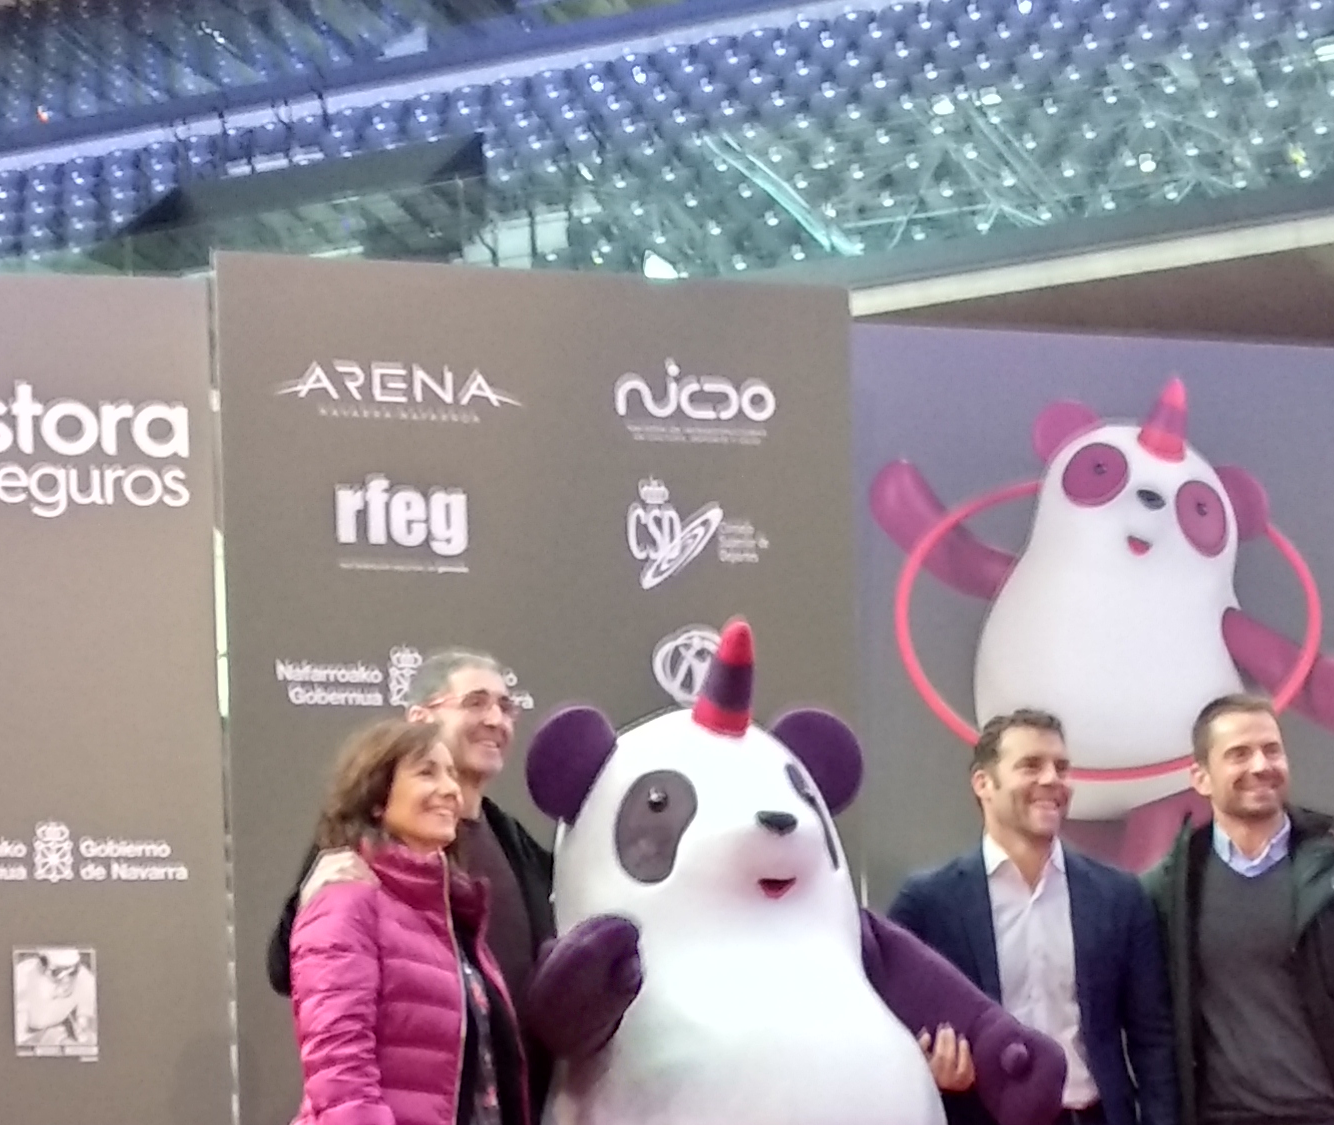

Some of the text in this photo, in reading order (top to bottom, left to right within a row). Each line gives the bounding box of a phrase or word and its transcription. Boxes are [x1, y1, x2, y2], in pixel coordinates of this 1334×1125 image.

[279, 360, 519, 407] ARENA
[335, 474, 468, 556] rfeg
[79, 836, 172, 858] Gobierno
[79, 860, 189, 881] de Navarra
